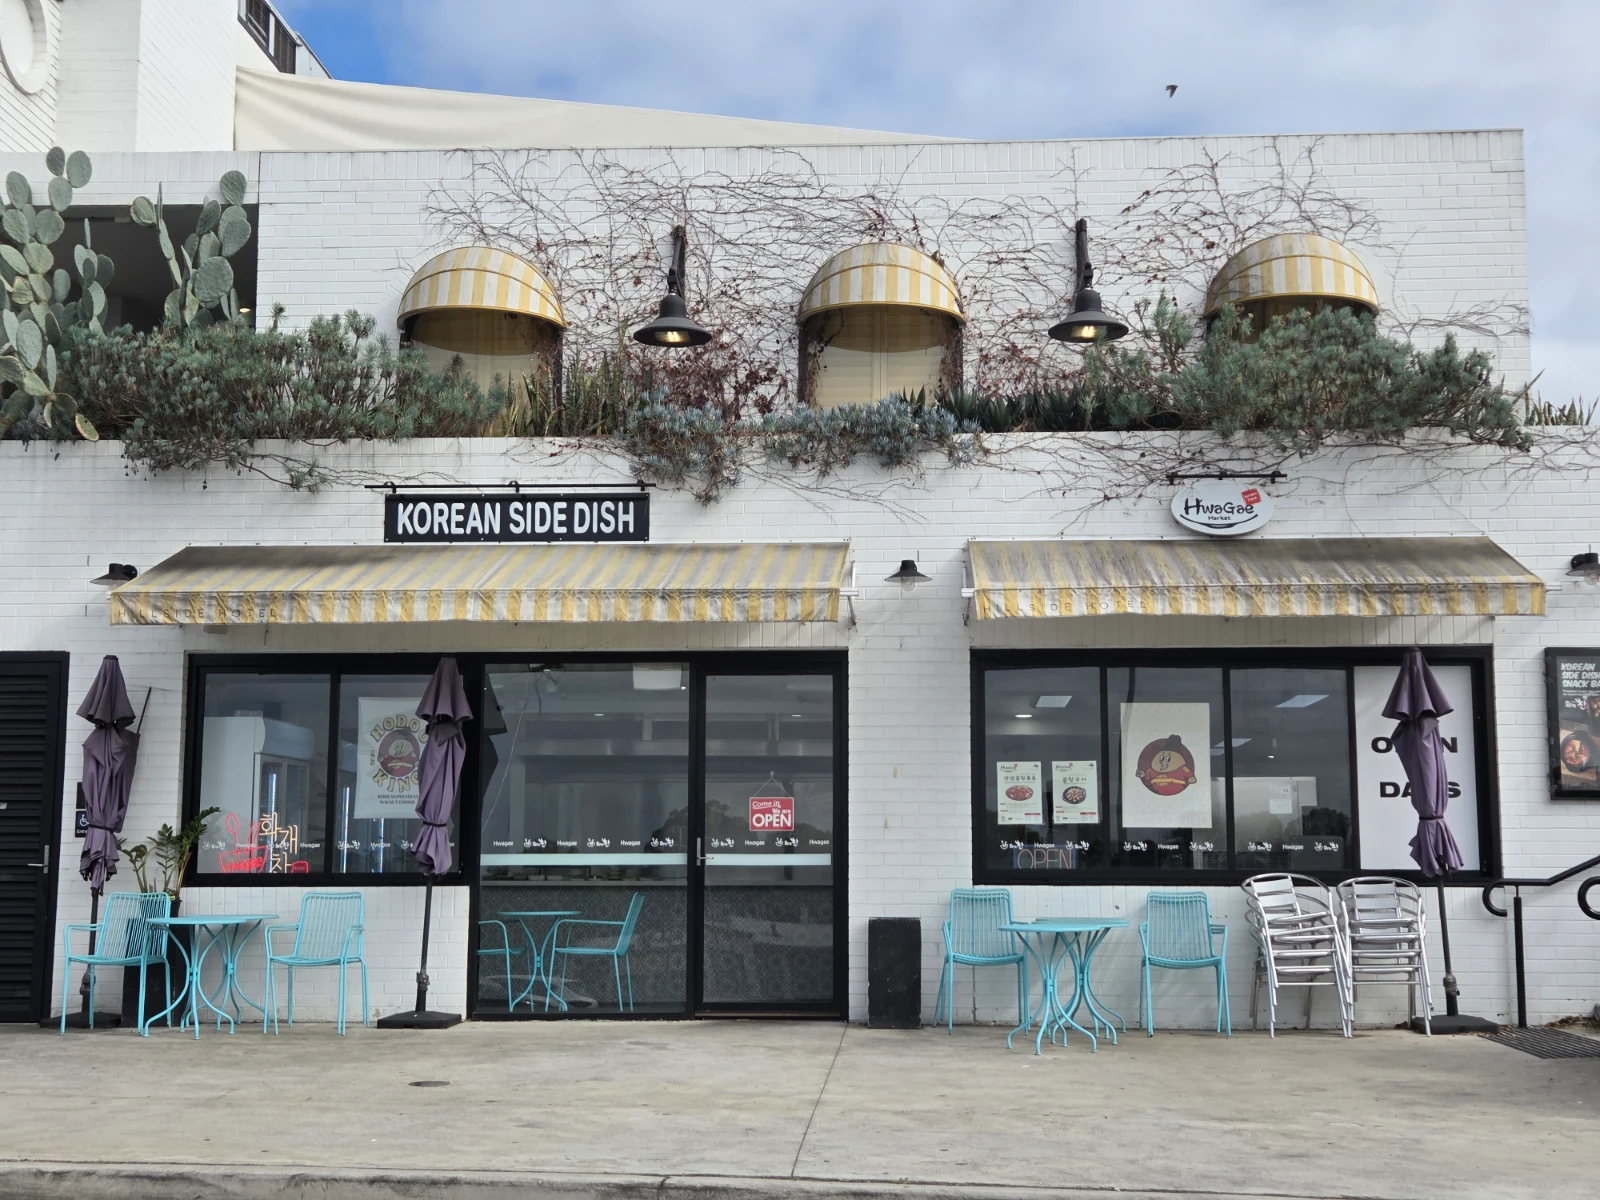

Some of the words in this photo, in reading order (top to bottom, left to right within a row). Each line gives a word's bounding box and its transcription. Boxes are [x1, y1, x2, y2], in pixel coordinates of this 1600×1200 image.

[1184, 497, 1255, 515] HwaGae
[397, 501, 501, 535] KOREAN
[509, 501, 567, 534] SIDE
[574, 501, 635, 534] DISH
[117, 607, 205, 619] HILLSIDE
[218, 607, 278, 618] HOTEL
[983, 601, 1071, 614] HILLSIDE
[1086, 599, 1146, 611] HOTEL
[1561, 662, 1595, 671] KOREAN
[1562, 671, 1580, 679] SIDE
[1562, 679, 1589, 688] SNACK
[1371, 737, 1458, 753] ON
[752, 801, 772, 809] Come
[752, 813, 791, 827] OPEN
[1017, 848, 1072, 869] OPEN
